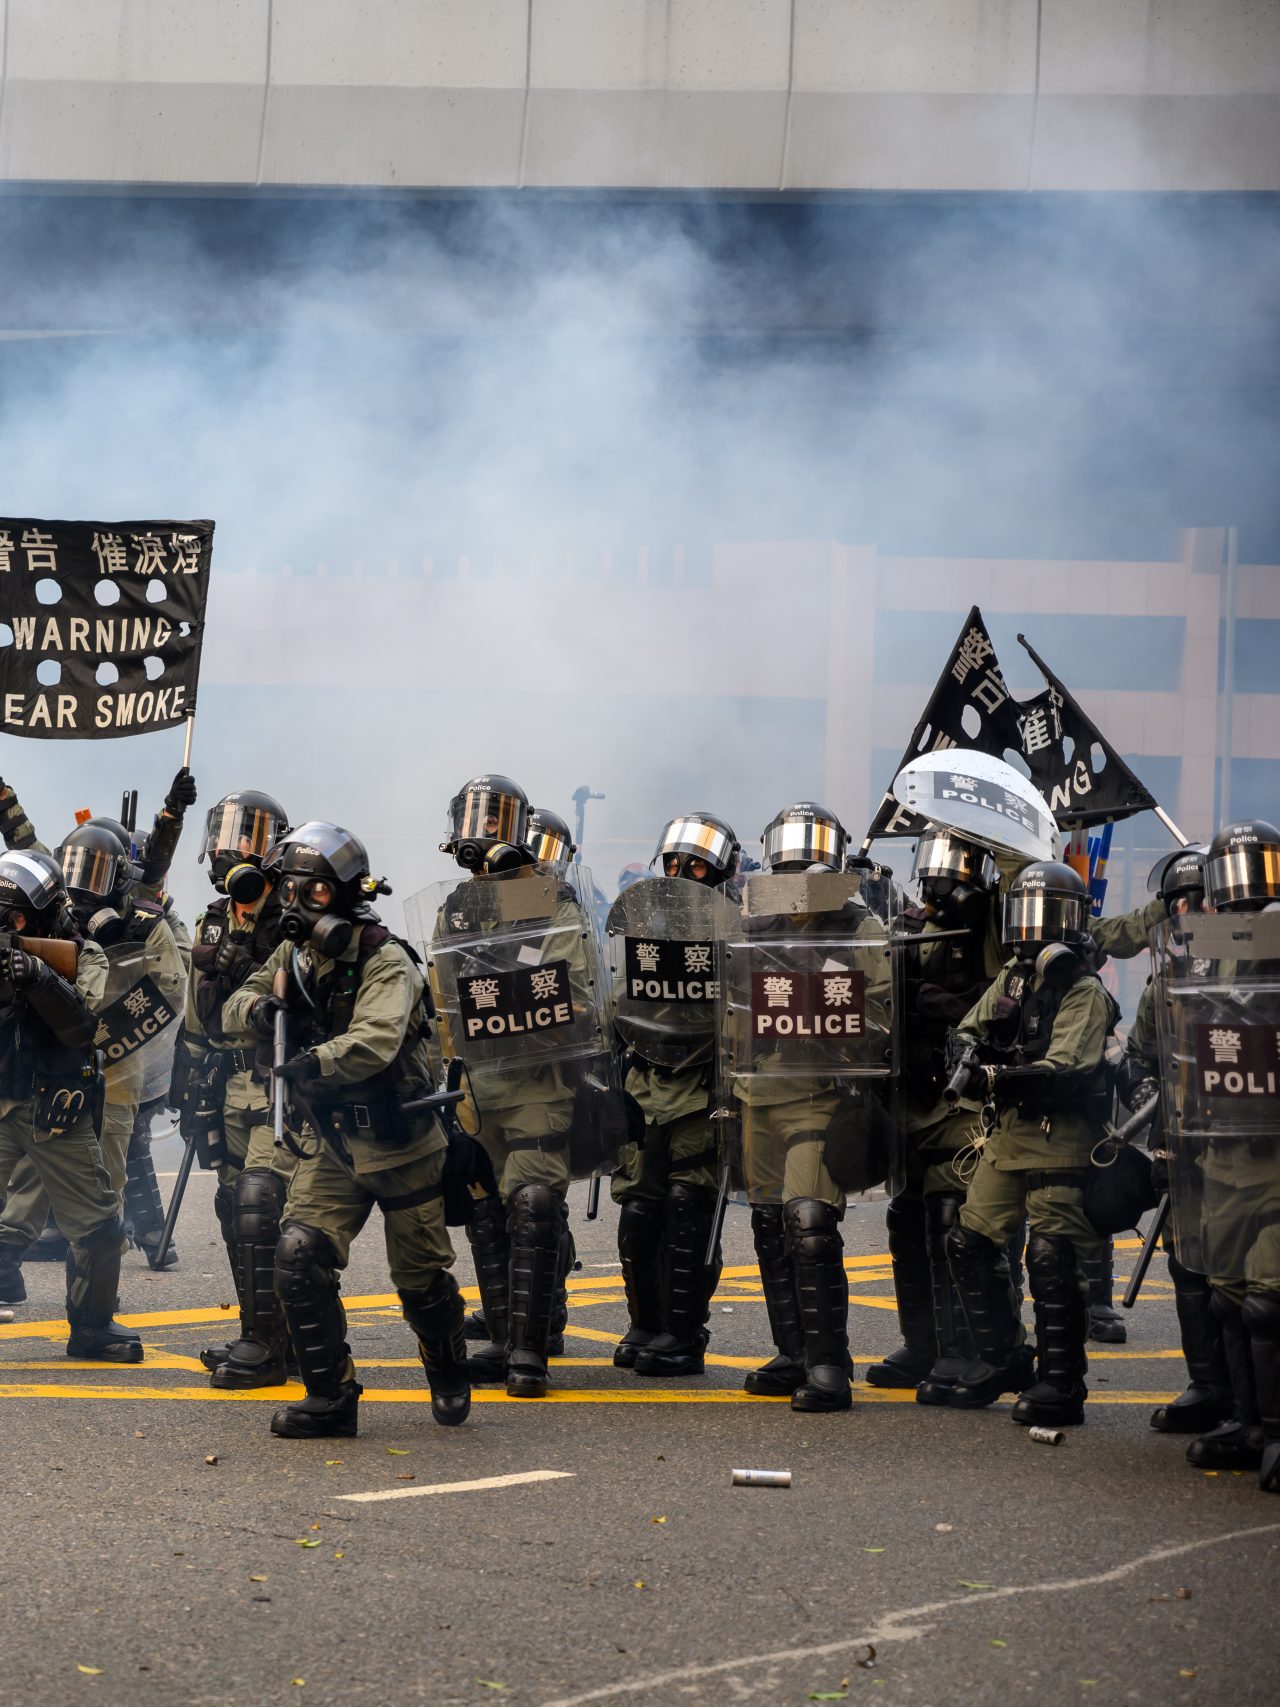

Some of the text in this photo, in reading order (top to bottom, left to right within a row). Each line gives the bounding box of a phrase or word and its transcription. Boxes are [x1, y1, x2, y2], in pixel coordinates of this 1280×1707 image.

[12, 616, 172, 653] WARNING
[95, 685, 186, 728] SMOKE
[942, 789, 1036, 833] POLICE
[295, 846, 320, 856] Police
[1230, 835, 1258, 845] Police
[1022, 880, 1046, 888] Police
[636, 943, 712, 973] 警察
[468, 968, 560, 1010] 警察
[632, 979, 721, 999] POLICE
[763, 976, 854, 1008] 警察
[103, 1005, 171, 1060] OLICE
[467, 1002, 571, 1037] POLICE
[757, 1014, 862, 1034] POLICE
[1204, 1070, 1280, 1094] POLI
